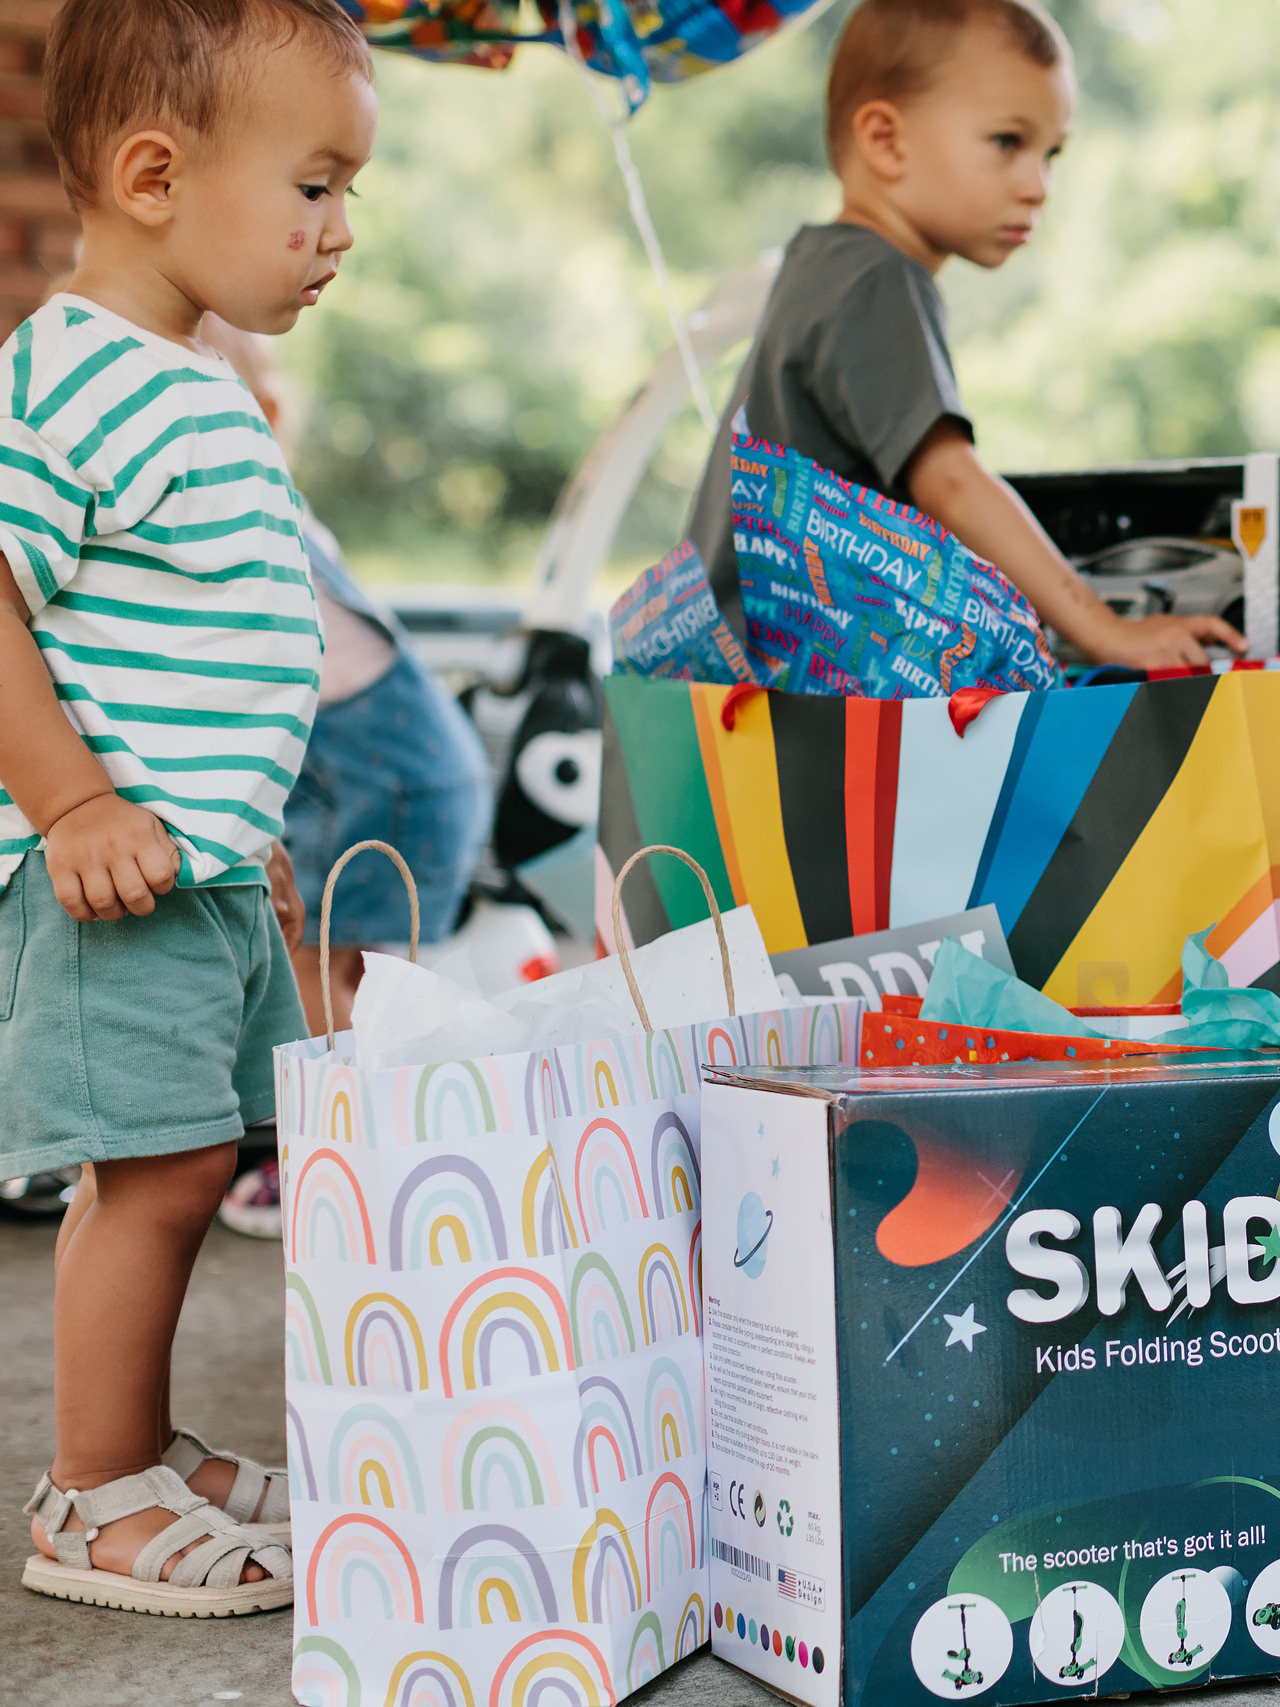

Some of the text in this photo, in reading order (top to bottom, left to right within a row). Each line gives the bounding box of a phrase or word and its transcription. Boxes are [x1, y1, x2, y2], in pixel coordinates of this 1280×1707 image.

[806, 508, 922, 590] BIRTHDAY
[785, 603, 847, 651] HAPPY
[963, 598, 1055, 690] BIRTHDAY
[1035, 1344, 1096, 1374] Kids
[1105, 1335, 1204, 1367] Folding
[999, 1524, 1266, 1573] The scooter that's got it all!
[798, 1588, 822, 1605] Design
